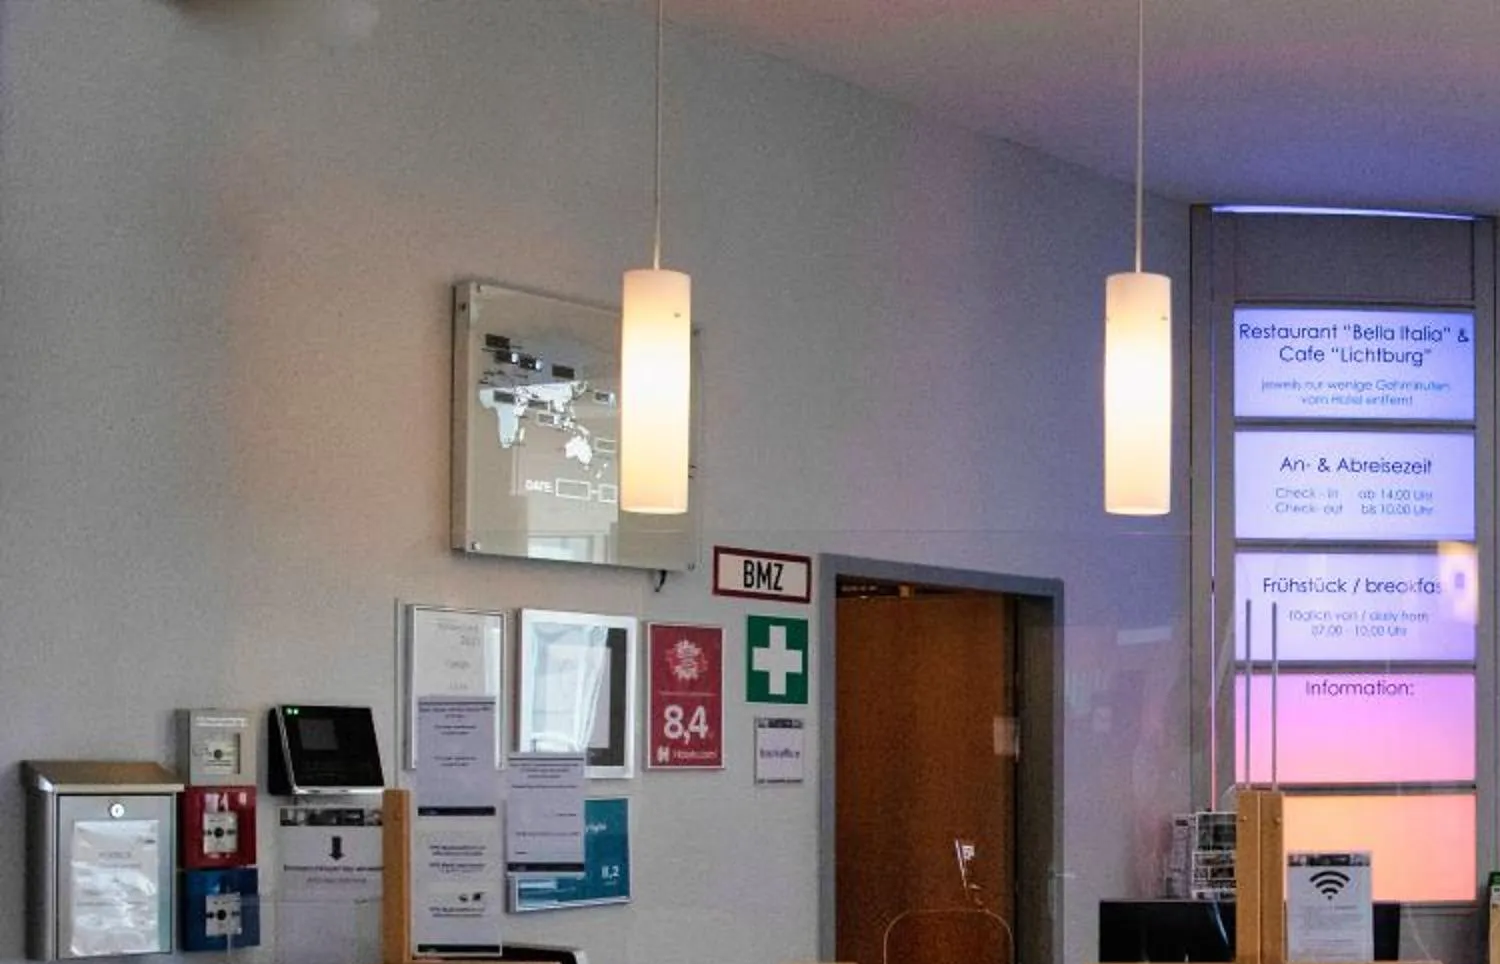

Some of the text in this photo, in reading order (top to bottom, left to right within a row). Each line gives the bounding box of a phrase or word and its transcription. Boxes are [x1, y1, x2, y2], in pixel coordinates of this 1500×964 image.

[1238, 324, 1470, 343] Restaurant "Bella Italia" &
[1278, 346, 1433, 367] Cafe "Lichtburg"
[1279, 456, 1433, 474] An- & Abreisezeit
[1275, 487, 1317, 501] Check
[1413, 488, 1434, 502] Uhr
[1413, 503, 1435, 516] Uhr
[742, 558, 785, 591] BMZ
[1262, 576, 1444, 594] Frühstück / breakfas
[1304, 679, 1416, 697] Information:
[663, 703, 709, 744] 8,4
